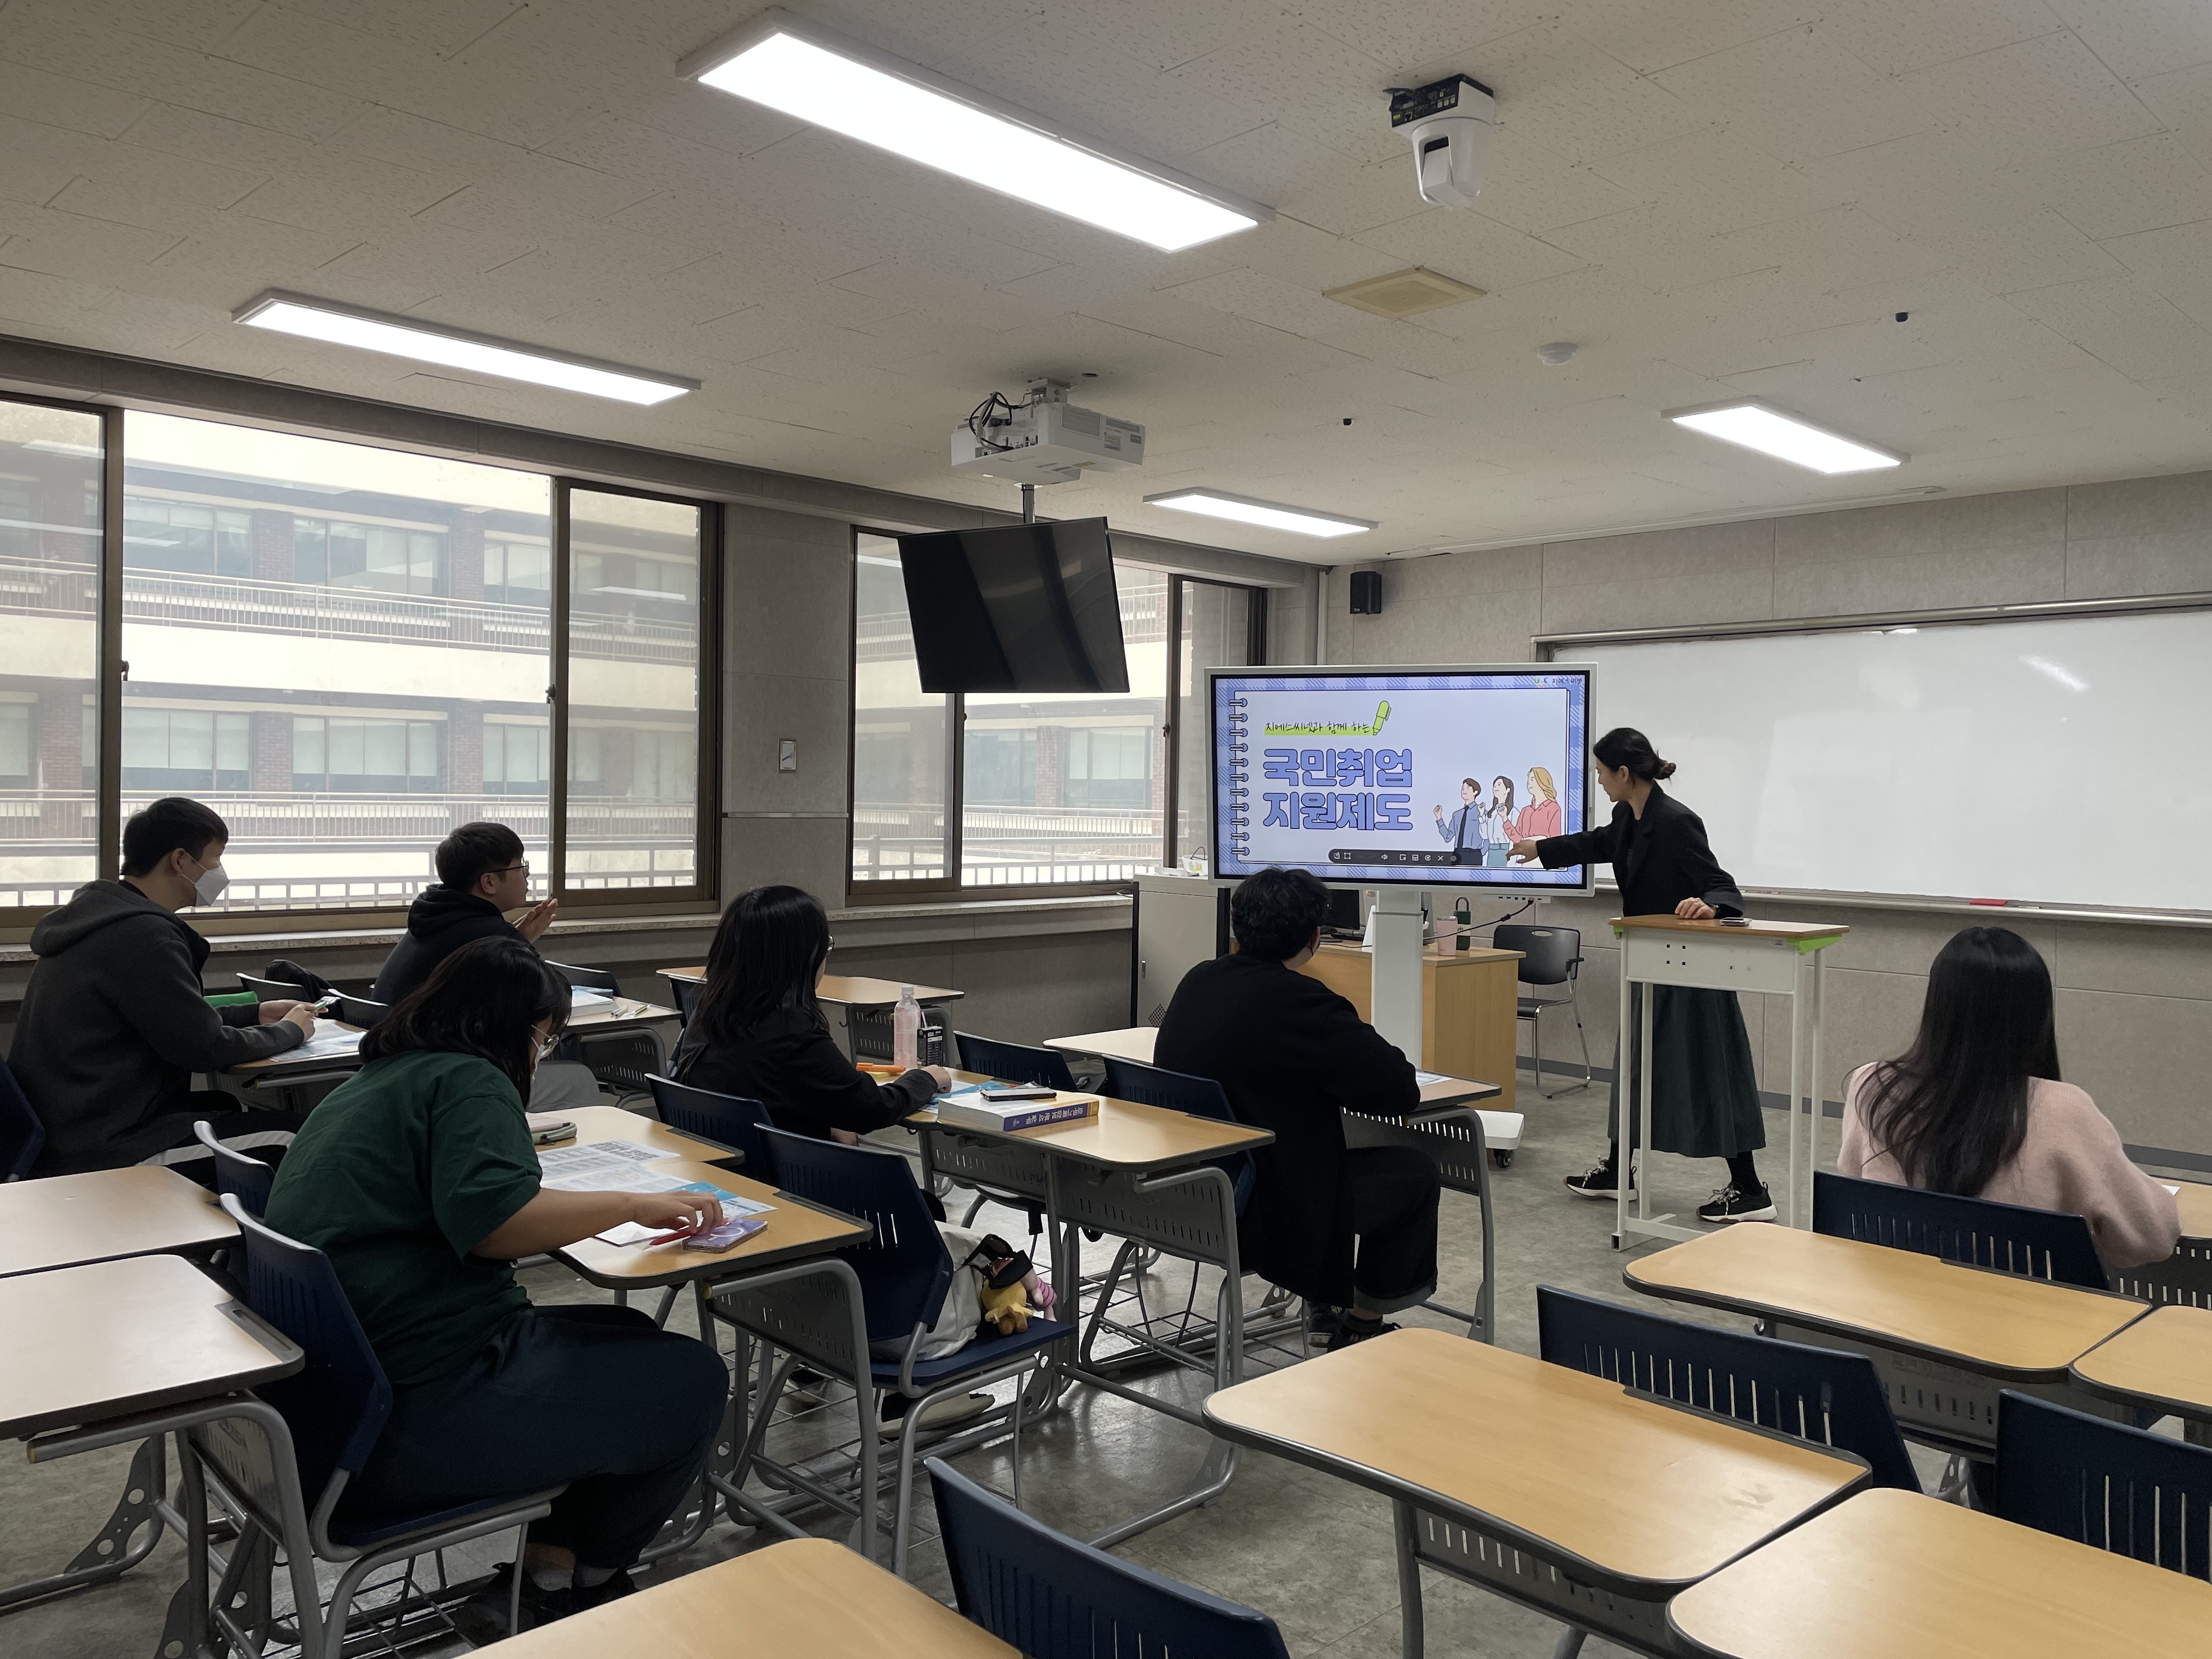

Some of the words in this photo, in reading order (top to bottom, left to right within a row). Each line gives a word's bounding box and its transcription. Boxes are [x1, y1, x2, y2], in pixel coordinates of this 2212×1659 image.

[1266, 721, 1323, 733] 지에스씨넷과
[1327, 721, 1347, 734] 함께
[1351, 721, 1370, 733] 하는
[1262, 748, 1412, 787] 국민취업
[1262, 791, 1413, 831] 지원제도
[1026, 1115, 1037, 1125] 실무
[1039, 1113, 1050, 1122] 분석
[1052, 1107, 1084, 1120] 의무기록정보
